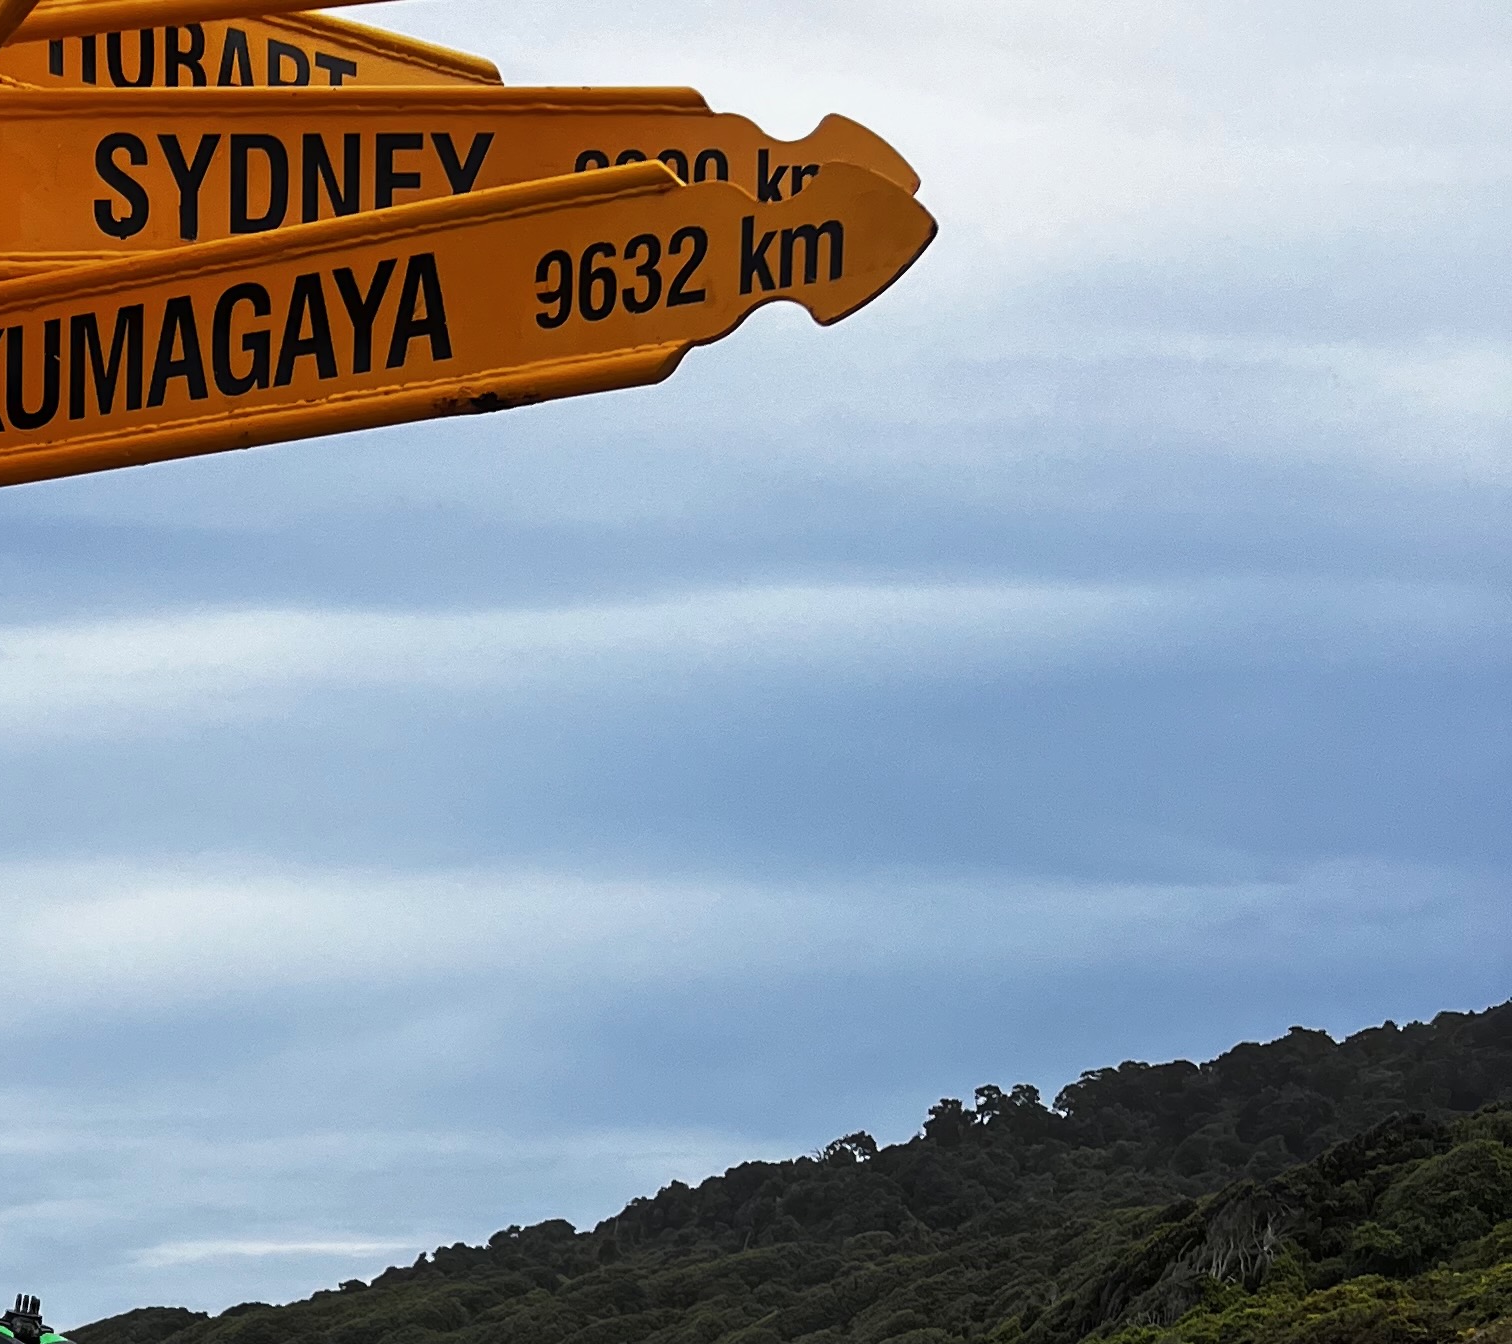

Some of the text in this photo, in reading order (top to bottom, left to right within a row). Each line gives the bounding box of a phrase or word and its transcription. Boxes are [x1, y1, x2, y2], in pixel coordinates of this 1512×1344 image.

[93, 132, 494, 241] SYDNEY
[534, 226, 708, 329] 9632
[740, 215, 844, 296] km
